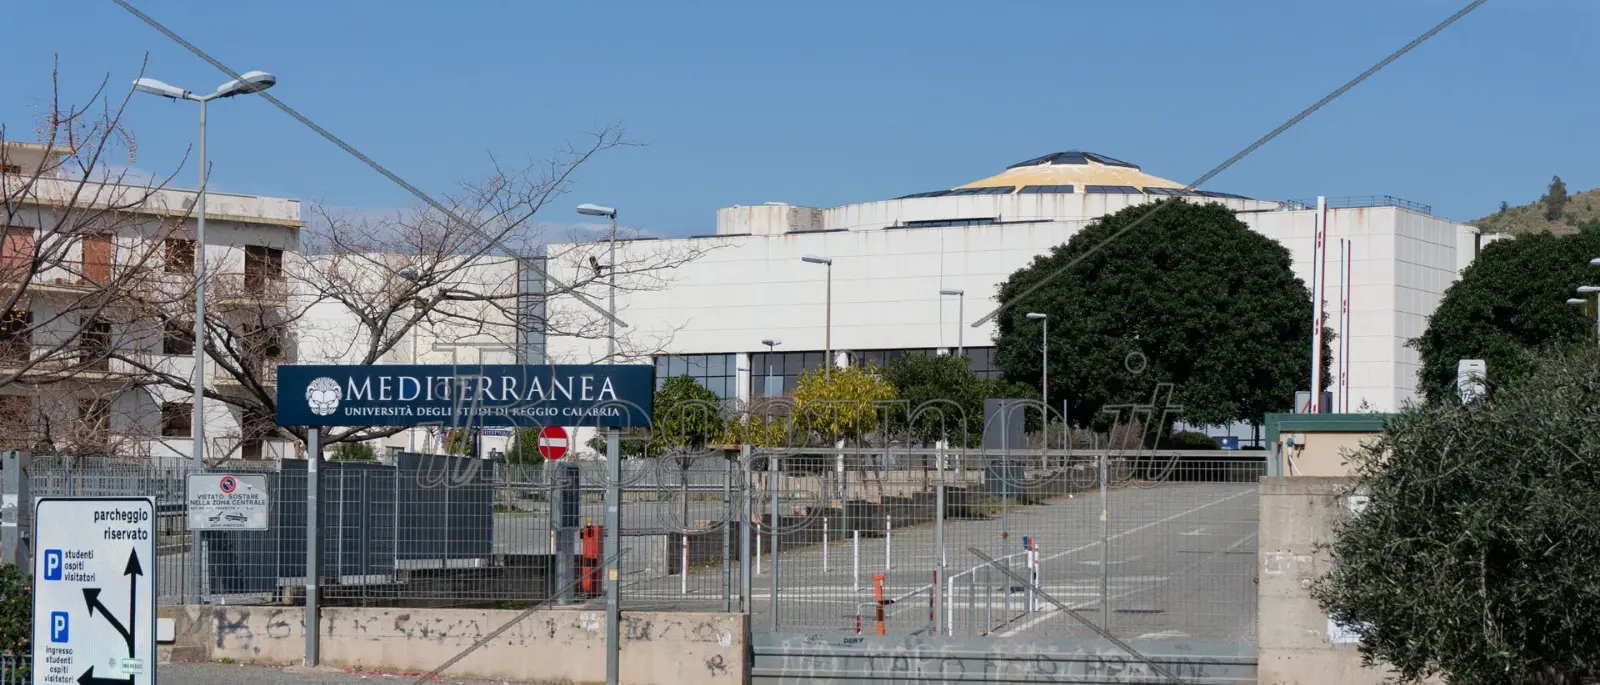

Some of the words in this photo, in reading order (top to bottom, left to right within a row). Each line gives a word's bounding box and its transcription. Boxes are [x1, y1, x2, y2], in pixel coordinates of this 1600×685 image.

[345, 375, 618, 401] MEDITERRANEA
[344, 405, 413, 416] UNIVERSITÀ
[416, 407, 452, 416] DEGLI
[456, 407, 492, 416] STUDI
[495, 407, 509, 416] DI
[512, 407, 559, 416] REGGIO
[562, 407, 620, 416] CALABRIA
[94, 508, 148, 523] parcheggio
[104, 527, 148, 540] riservato
[65, 550, 94, 559] studenti
[48, 553, 58, 577] P
[64, 561, 84, 571] ospiti
[64, 572, 96, 582] visitatori
[54, 615, 65, 639] P
[45, 646, 73, 655] ingresso
[46, 656, 73, 664] studenti
[50, 666, 69, 674] ospiti
[44, 674, 74, 683] visitatori
